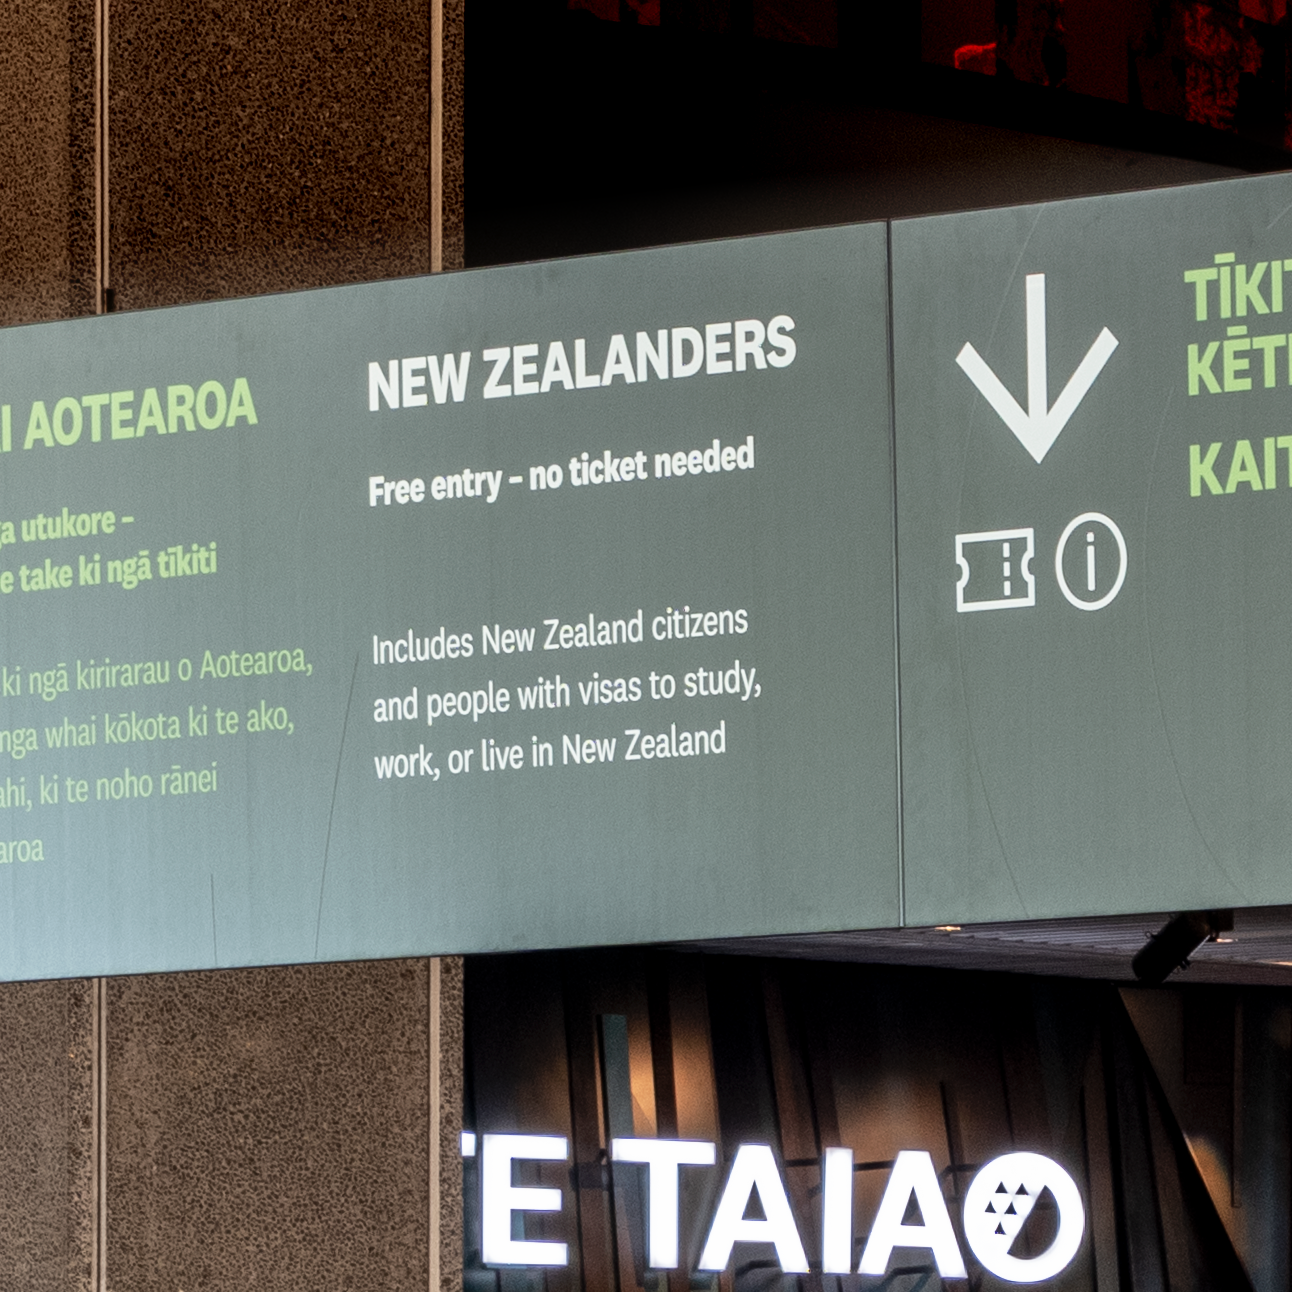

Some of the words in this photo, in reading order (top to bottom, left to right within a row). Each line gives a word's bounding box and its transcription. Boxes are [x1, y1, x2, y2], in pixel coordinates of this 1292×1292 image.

[368, 351, 471, 412] NEW
[482, 314, 797, 400] ZEALANDERS
[23, 377, 259, 450] AOTEAROA
[368, 475, 426, 507] Free
[430, 468, 503, 504] entry
[529, 464, 564, 491] no
[568, 449, 649, 487] ticket
[654, 435, 755, 479] needed
[21, 506, 116, 543] utukore
[18, 558, 73, 592] take
[78, 552, 101, 586] ki
[107, 549, 153, 590] ngā
[156, 541, 217, 579] tīkiti
[372, 626, 474, 665] Includes
[482, 623, 536, 656] New
[543, 608, 644, 650] Zealand
[651, 605, 749, 641] citizens
[2, 665, 21, 697] ki
[29, 662, 70, 702] ngā
[76, 657, 170, 691] kirirarau
[177, 658, 193, 682] o
[199, 648, 313, 680] Aotearoa,
[373, 686, 418, 723] and
[426, 680, 510, 727] people
[516, 674, 571, 711] with
[578, 671, 642, 706] visas
[648, 671, 676, 700] to
[683, 659, 762, 702] study,
[44, 714, 96, 749] whai
[104, 710, 182, 744] kōkota
[188, 704, 208, 737] ki
[214, 707, 239, 735] te
[246, 699, 295, 735] ako,
[373, 744, 441, 782] work,
[447, 748, 474, 774] or
[481, 738, 524, 772] live
[531, 735, 554, 768] in
[562, 733, 617, 765] New
[624, 719, 726, 761] Zealand
[39, 774, 59, 805] ki
[65, 776, 89, 803] te
[96, 767, 153, 801] noho
[160, 761, 217, 796] rānei
[461, 1131, 568, 1268] E
[611, 1136, 1086, 1283] TAIAO
